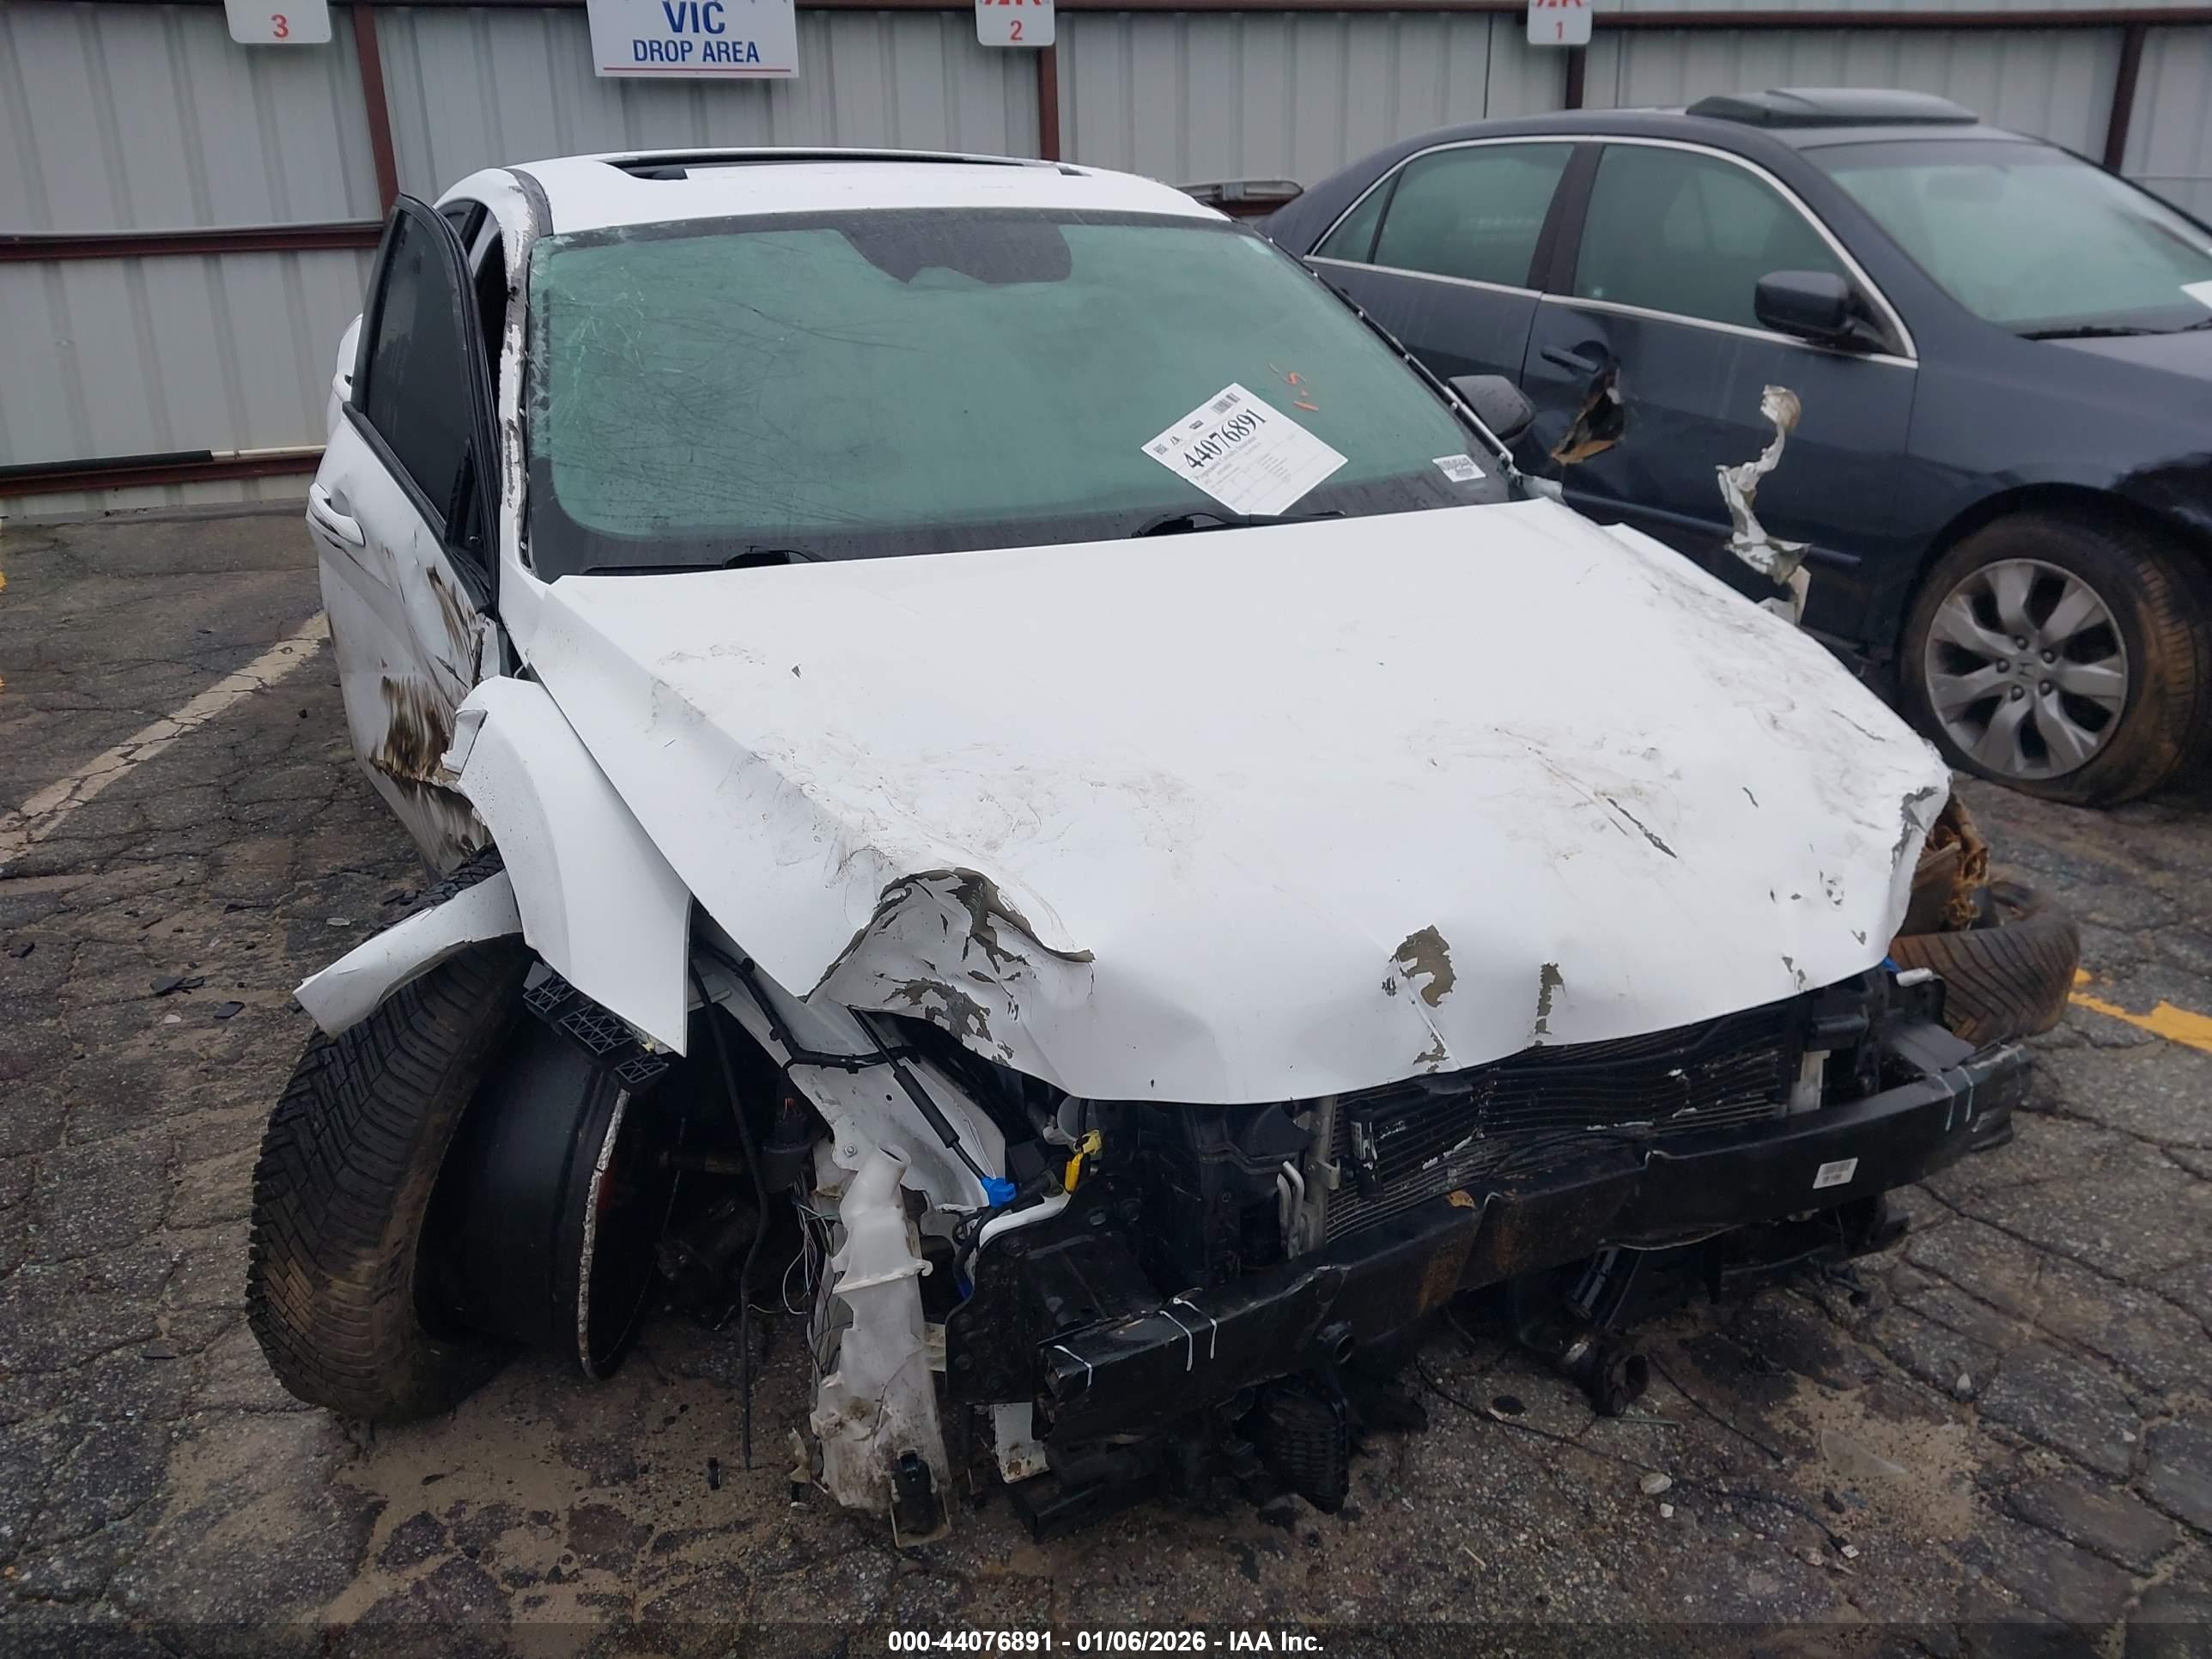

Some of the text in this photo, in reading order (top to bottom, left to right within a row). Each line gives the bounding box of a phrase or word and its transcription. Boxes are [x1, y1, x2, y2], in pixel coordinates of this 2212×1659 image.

[271, 14, 289, 38] 3
[663, 1, 726, 33] VIC
[1010, 20, 1023, 40] 2
[1555, 21, 1563, 40] 1
[633, 40, 760, 63] DROP AREA
[1183, 408, 1267, 469] 44076891
